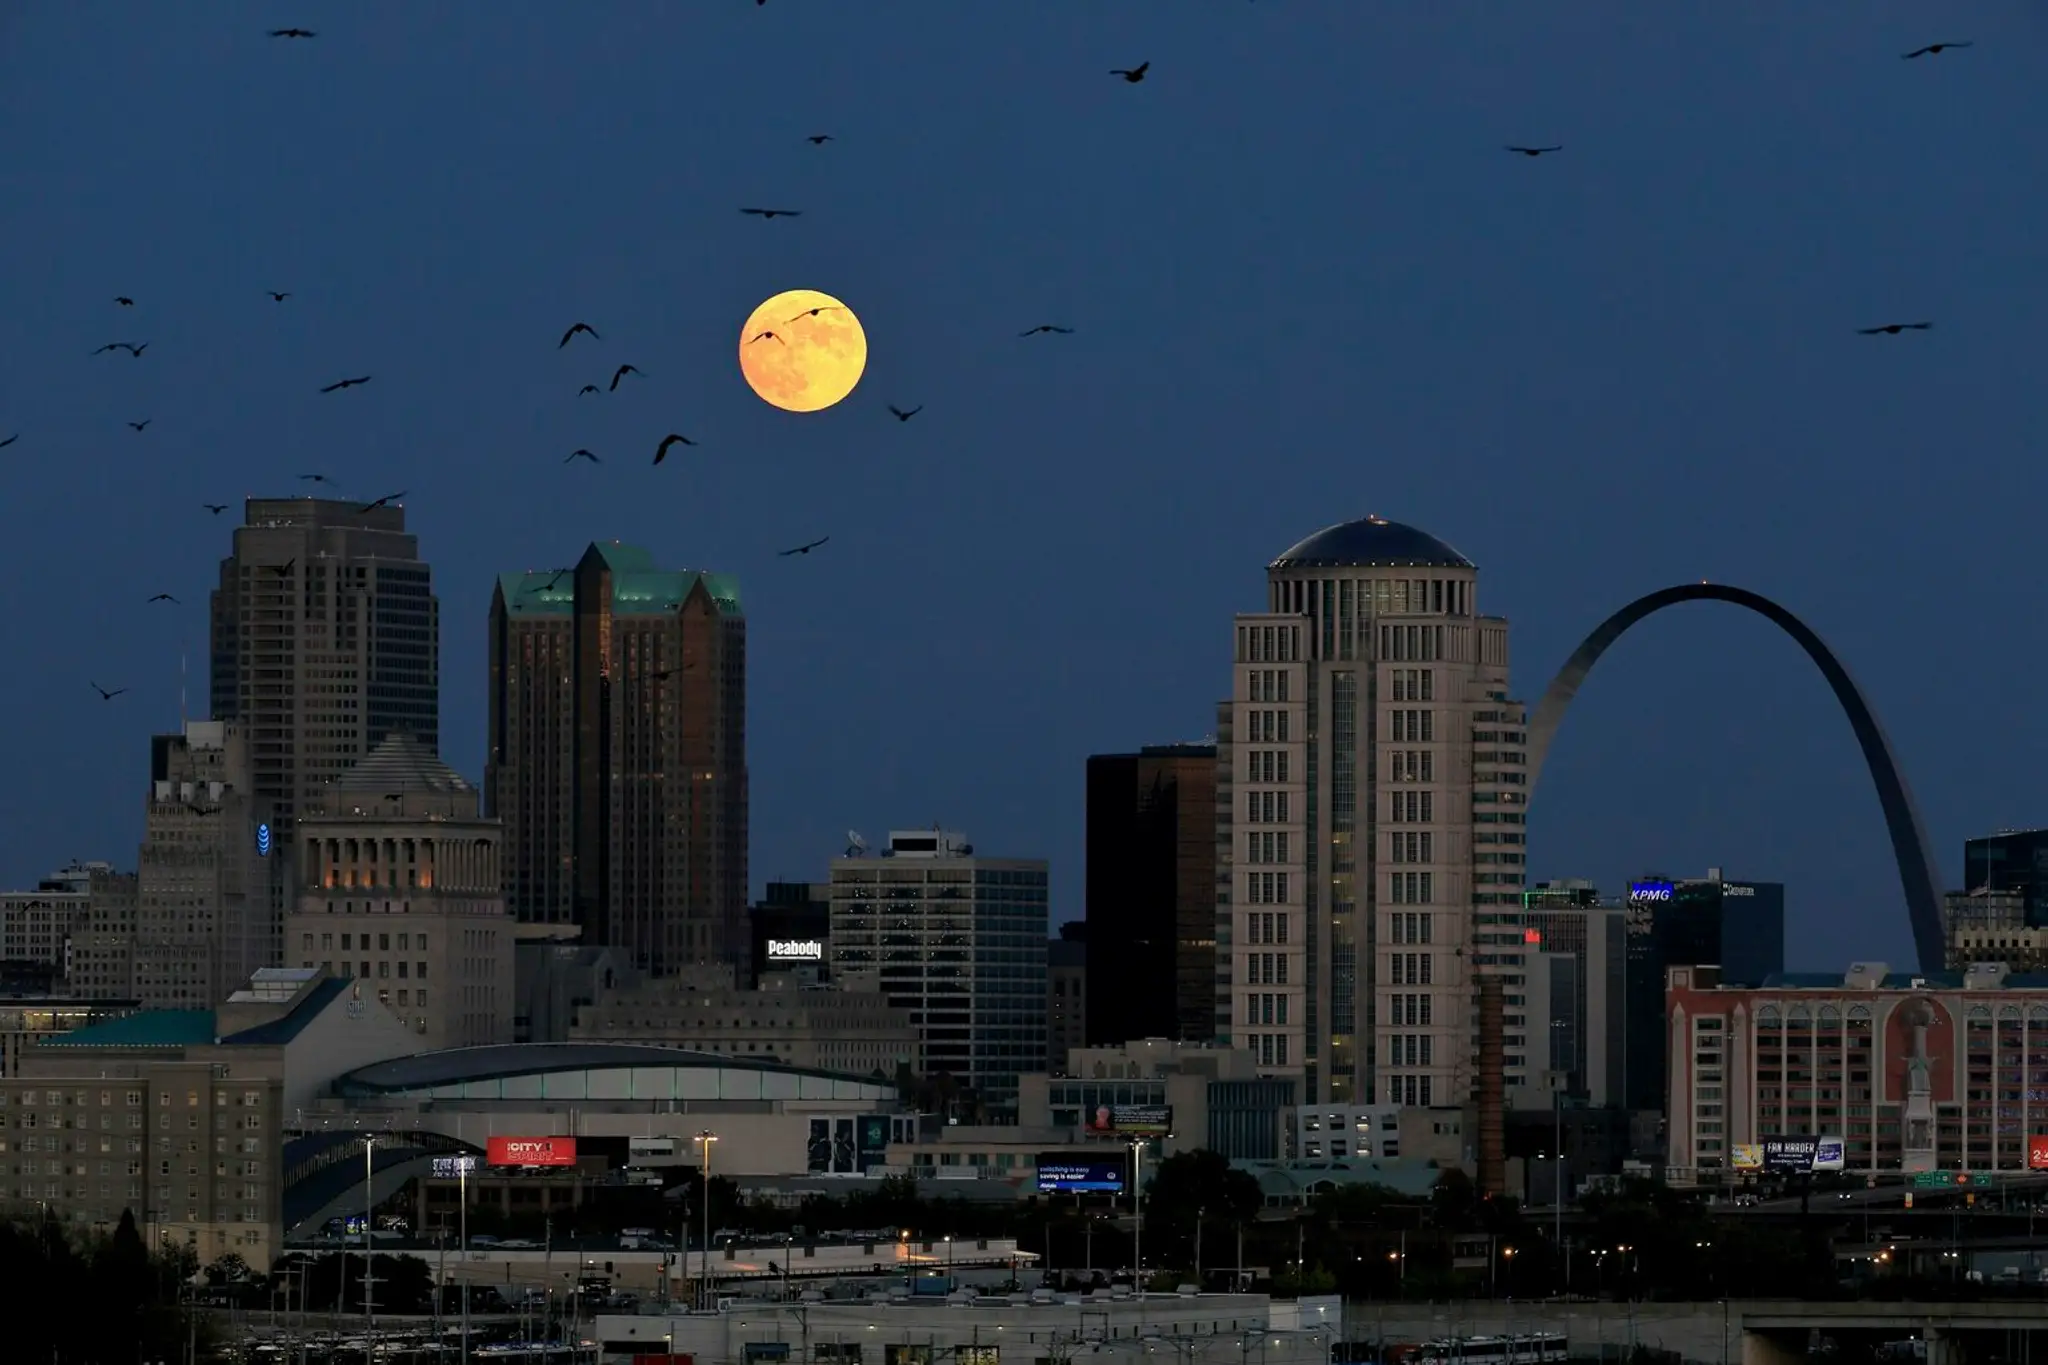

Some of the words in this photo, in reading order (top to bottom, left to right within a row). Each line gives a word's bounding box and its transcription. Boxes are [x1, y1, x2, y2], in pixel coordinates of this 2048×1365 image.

[1630, 889, 1670, 901] KPMG
[768, 940, 822, 960] Peabody
[510, 1142, 542, 1152] CITY
[1767, 1142, 1782, 1153] FAN
[1784, 1142, 1815, 1153] HARDER
[508, 1152, 554, 1161] SPIRIT
[1039, 1165, 1068, 1173] switching
